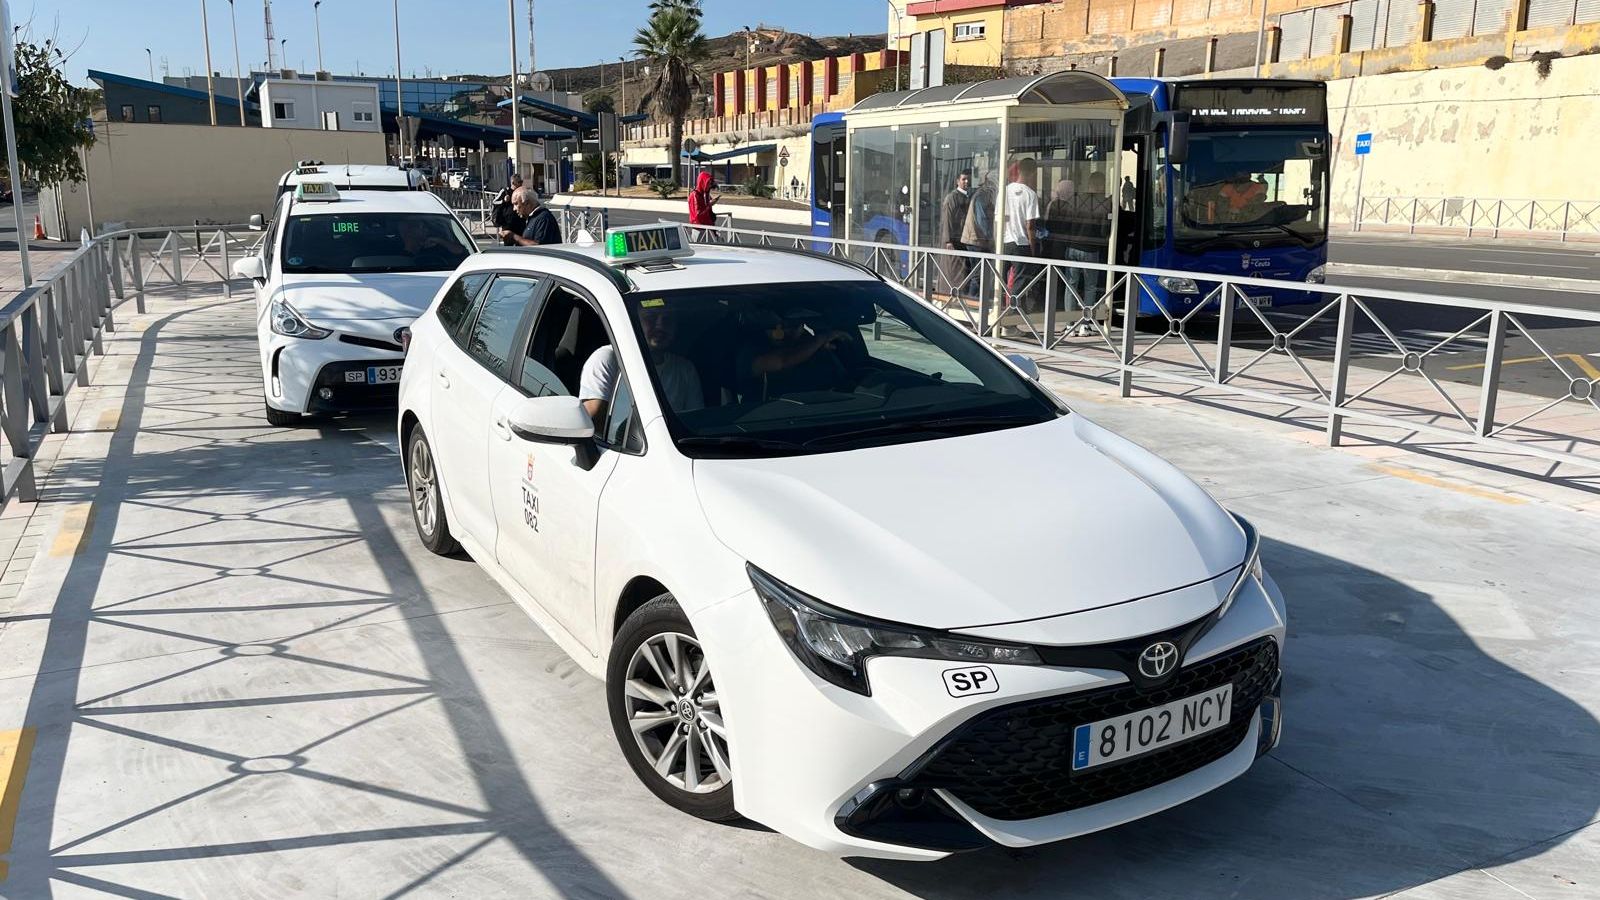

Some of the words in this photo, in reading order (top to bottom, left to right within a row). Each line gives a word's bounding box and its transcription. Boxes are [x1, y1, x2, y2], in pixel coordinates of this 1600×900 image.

[303, 184, 323, 193] TAXI
[333, 222, 359, 232] LIBRE
[628, 230, 664, 252] TAXI
[348, 372, 363, 381] SP
[522, 486, 540, 514] TAXI
[524, 508, 539, 533] 082
[951, 670, 989, 692] SP
[1078, 751, 1086, 761] E
[1099, 710, 1172, 758] 8102
[1181, 690, 1229, 735] NCY
